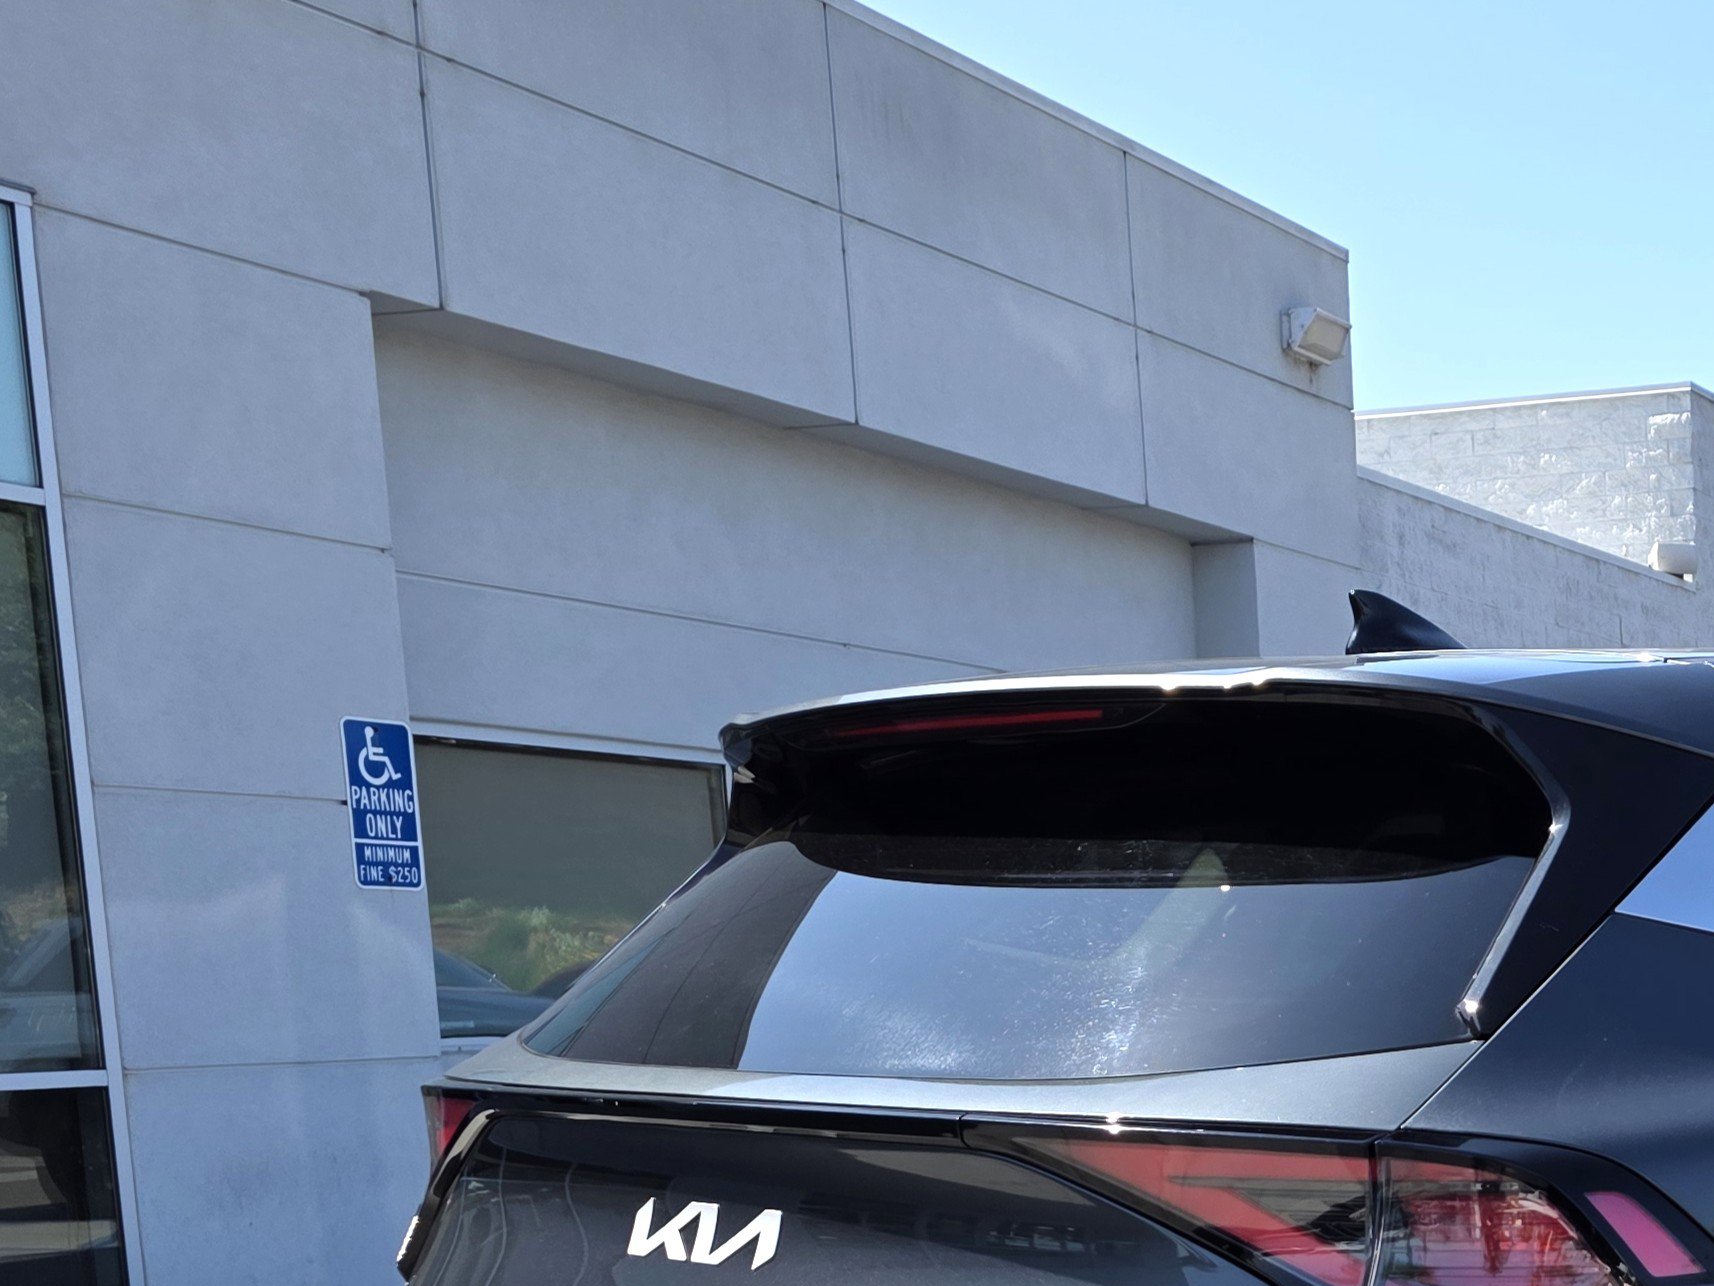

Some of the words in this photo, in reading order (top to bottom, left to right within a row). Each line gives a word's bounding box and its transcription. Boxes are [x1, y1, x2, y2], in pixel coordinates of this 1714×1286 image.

[352, 786, 414, 813] PARKING
[366, 814, 402, 838] ONLY
[364, 846, 411, 864] MINIMUM
[360, 865, 385, 882] FINE
[388, 866, 418, 883] $250
[627, 1196, 783, 1271] KIA
